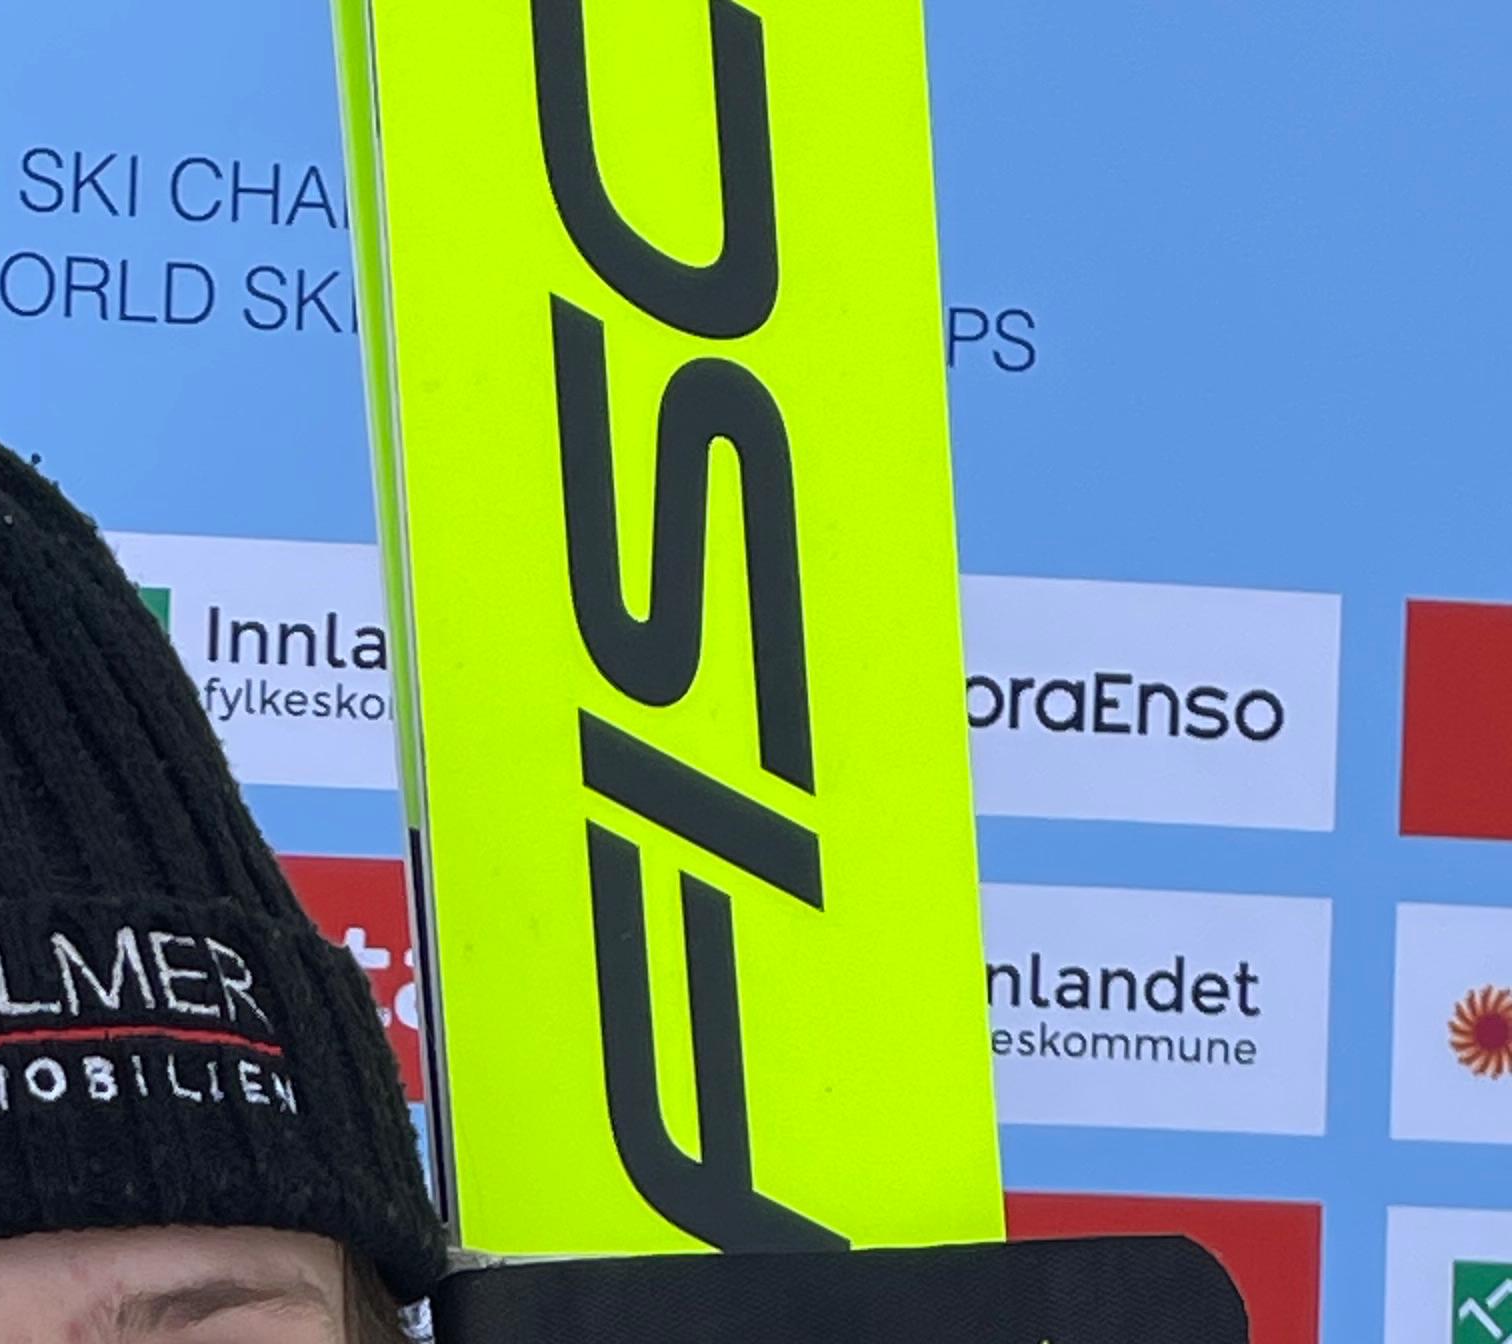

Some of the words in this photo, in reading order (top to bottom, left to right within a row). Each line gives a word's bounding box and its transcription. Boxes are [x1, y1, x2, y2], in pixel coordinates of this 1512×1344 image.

[18, 147, 139, 218] SKI
[169, 156, 349, 229] CHA
[203, 677, 393, 722] fylkesko
